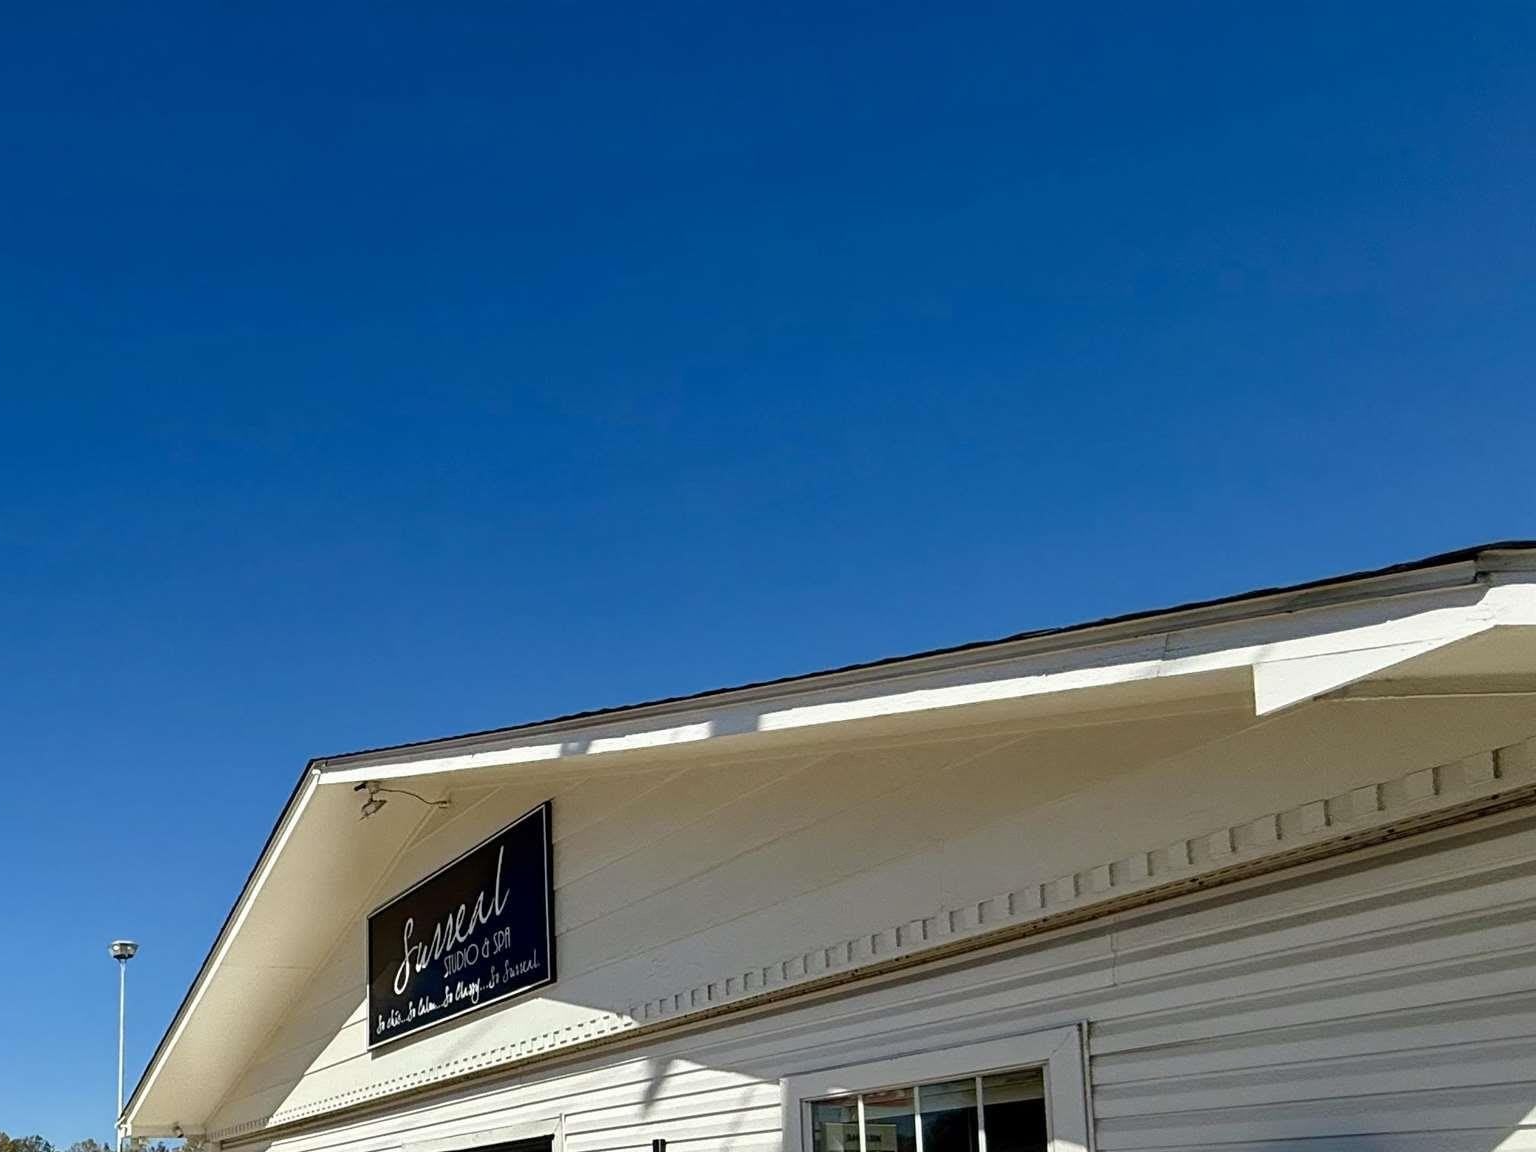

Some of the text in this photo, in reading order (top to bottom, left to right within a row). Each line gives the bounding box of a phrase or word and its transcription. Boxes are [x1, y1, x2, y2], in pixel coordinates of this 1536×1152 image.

[394, 845, 511, 995] Surreal
[443, 943, 479, 978] STUDIO
[493, 926, 512, 955] SPA
